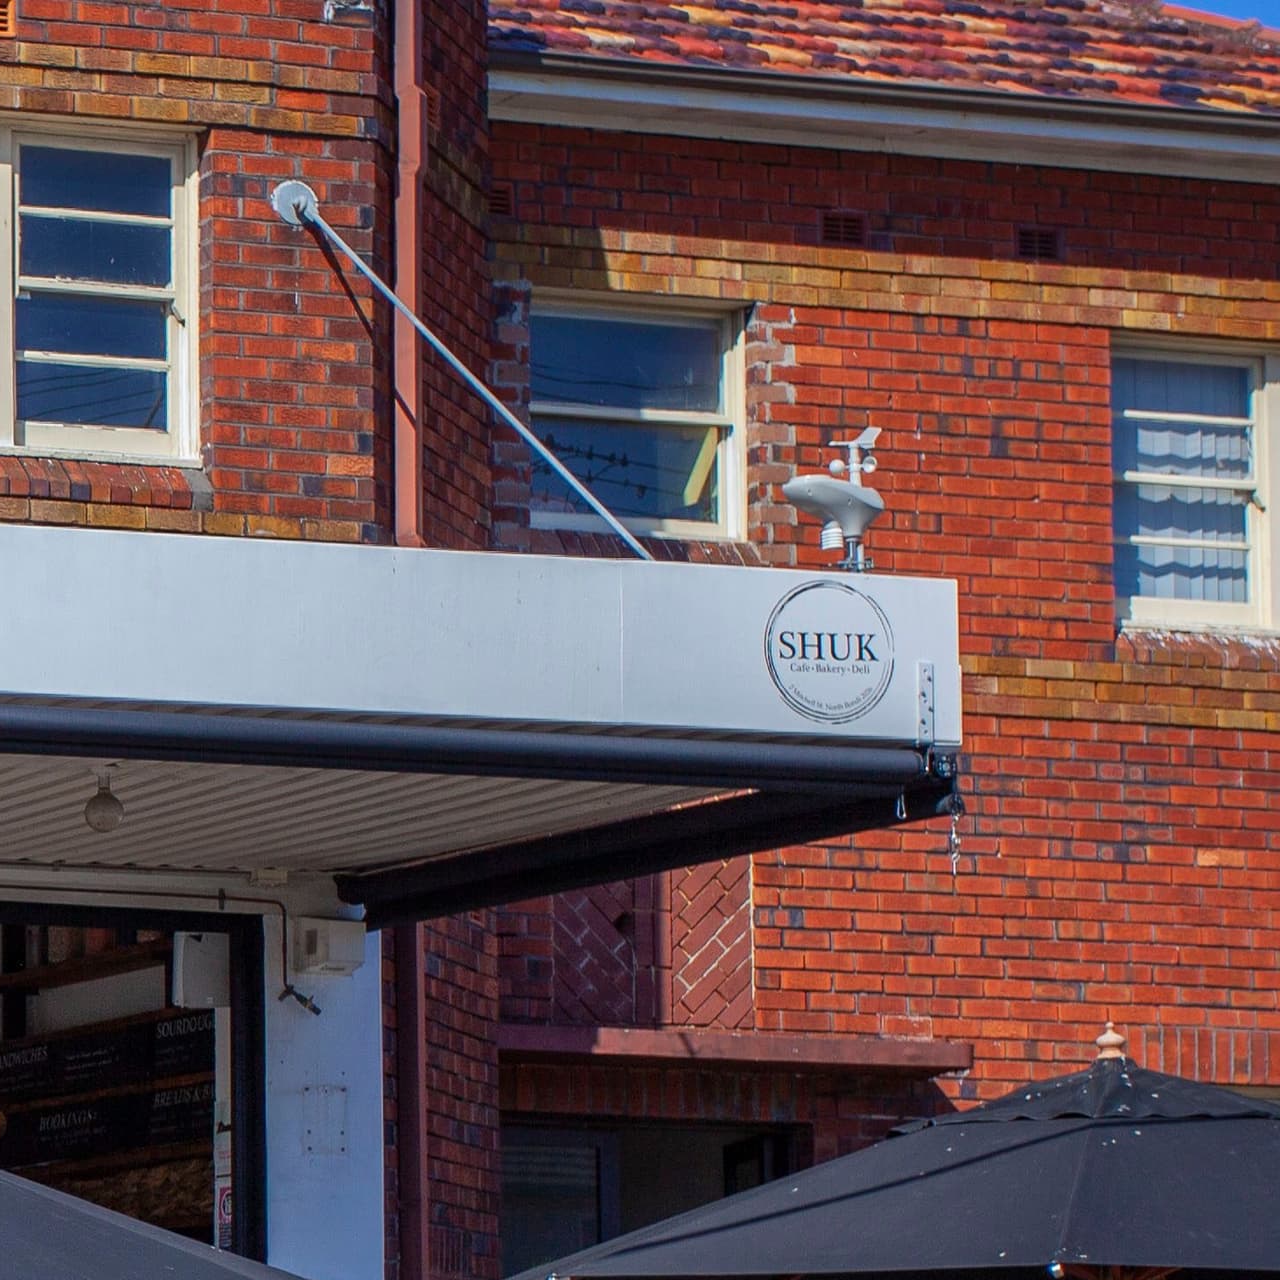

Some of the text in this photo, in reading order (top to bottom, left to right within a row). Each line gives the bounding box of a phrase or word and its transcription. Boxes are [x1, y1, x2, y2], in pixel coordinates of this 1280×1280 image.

[779, 631, 879, 661] SHUK
[790, 663, 870, 676] Cafe Bakery Deli
[156, 1015, 212, 1039] SOURDOUG
